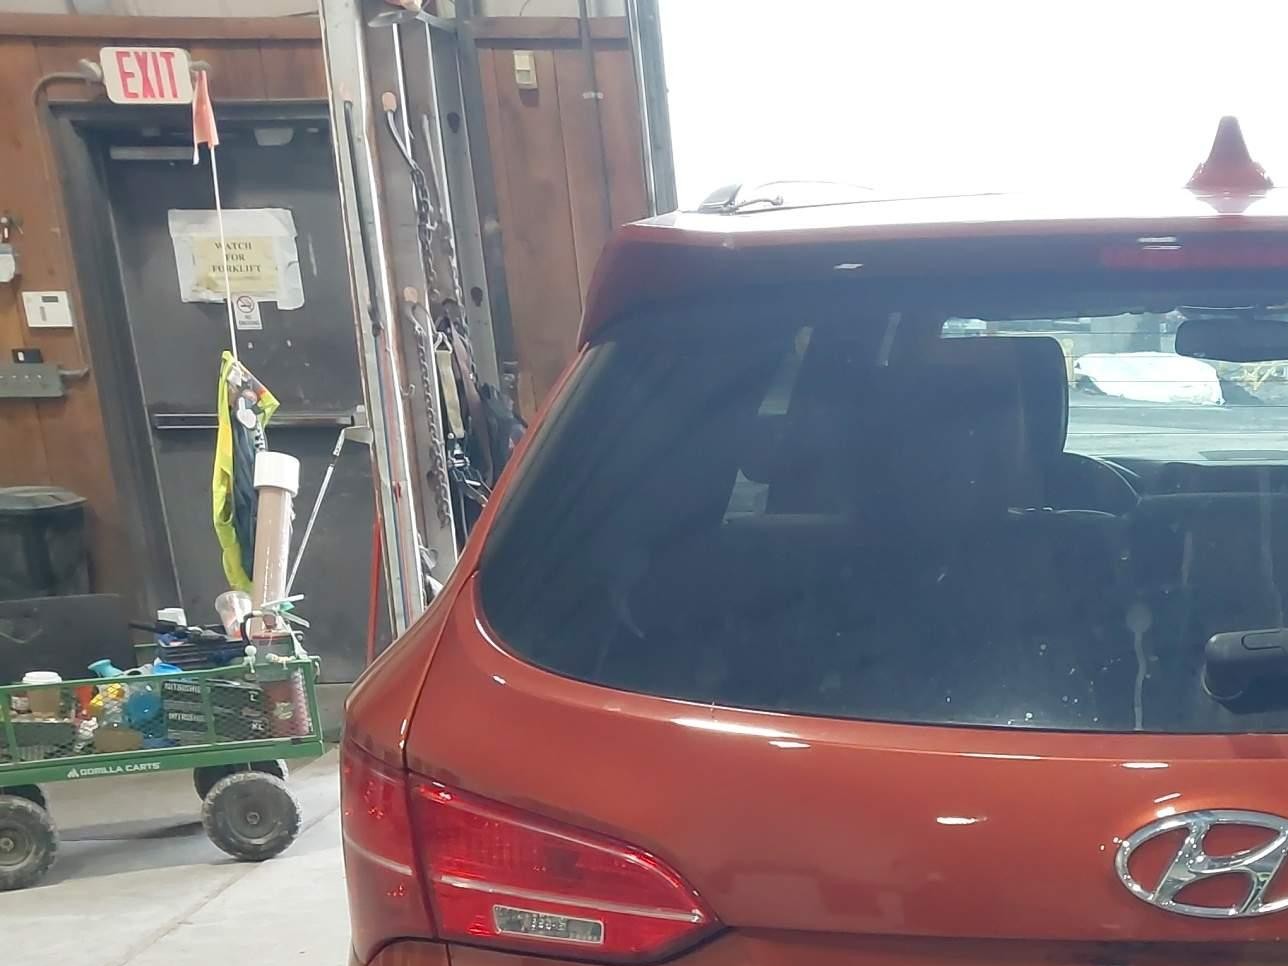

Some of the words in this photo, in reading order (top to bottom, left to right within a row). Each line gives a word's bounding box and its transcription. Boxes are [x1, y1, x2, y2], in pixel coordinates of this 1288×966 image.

[115, 51, 178, 98] EXIT
[214, 241, 252, 250] WATCH
[225, 253, 246, 262] FOR
[212, 264, 261, 272] FORKLIFT
[80, 766, 123, 776] GORILLA
[125, 762, 160, 772] CARTS
